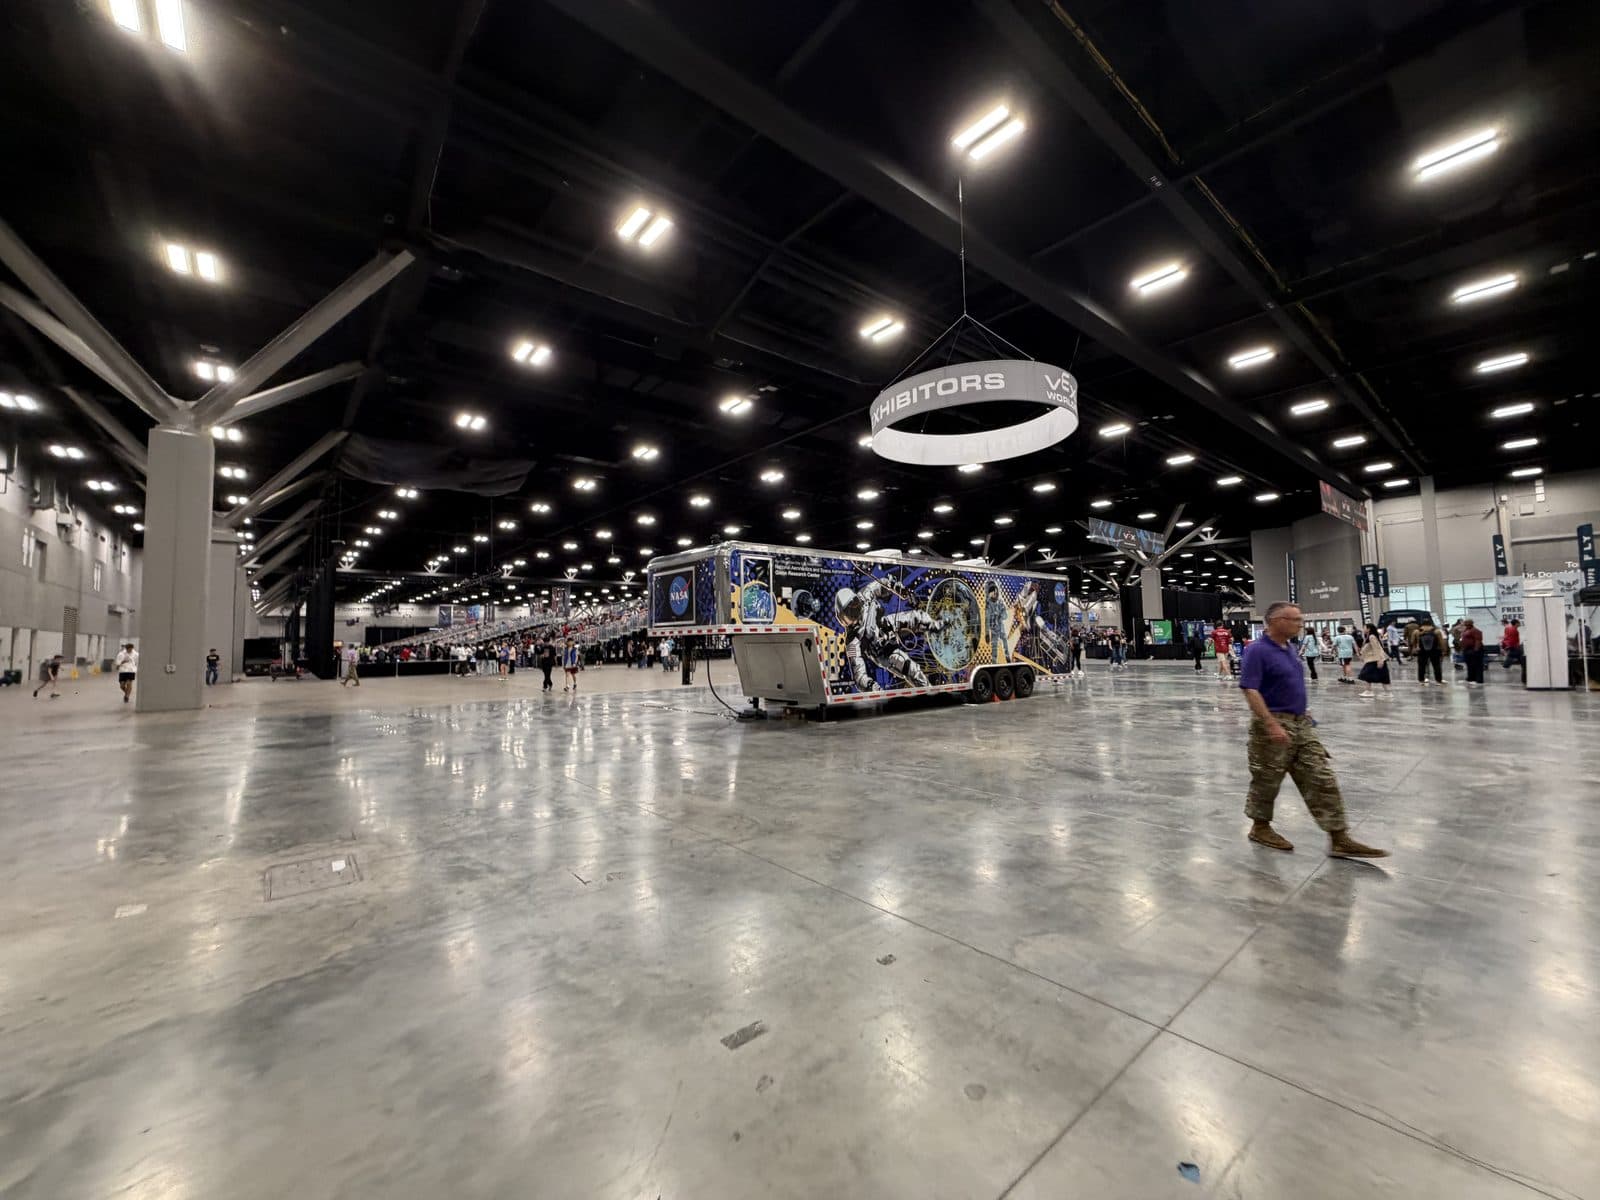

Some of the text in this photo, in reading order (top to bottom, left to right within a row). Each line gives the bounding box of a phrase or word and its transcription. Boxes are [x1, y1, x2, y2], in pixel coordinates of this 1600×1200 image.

[1496, 544, 1506, 567] FLY
[1582, 535, 1593, 561] FLY
[670, 591, 688, 601] NASA
